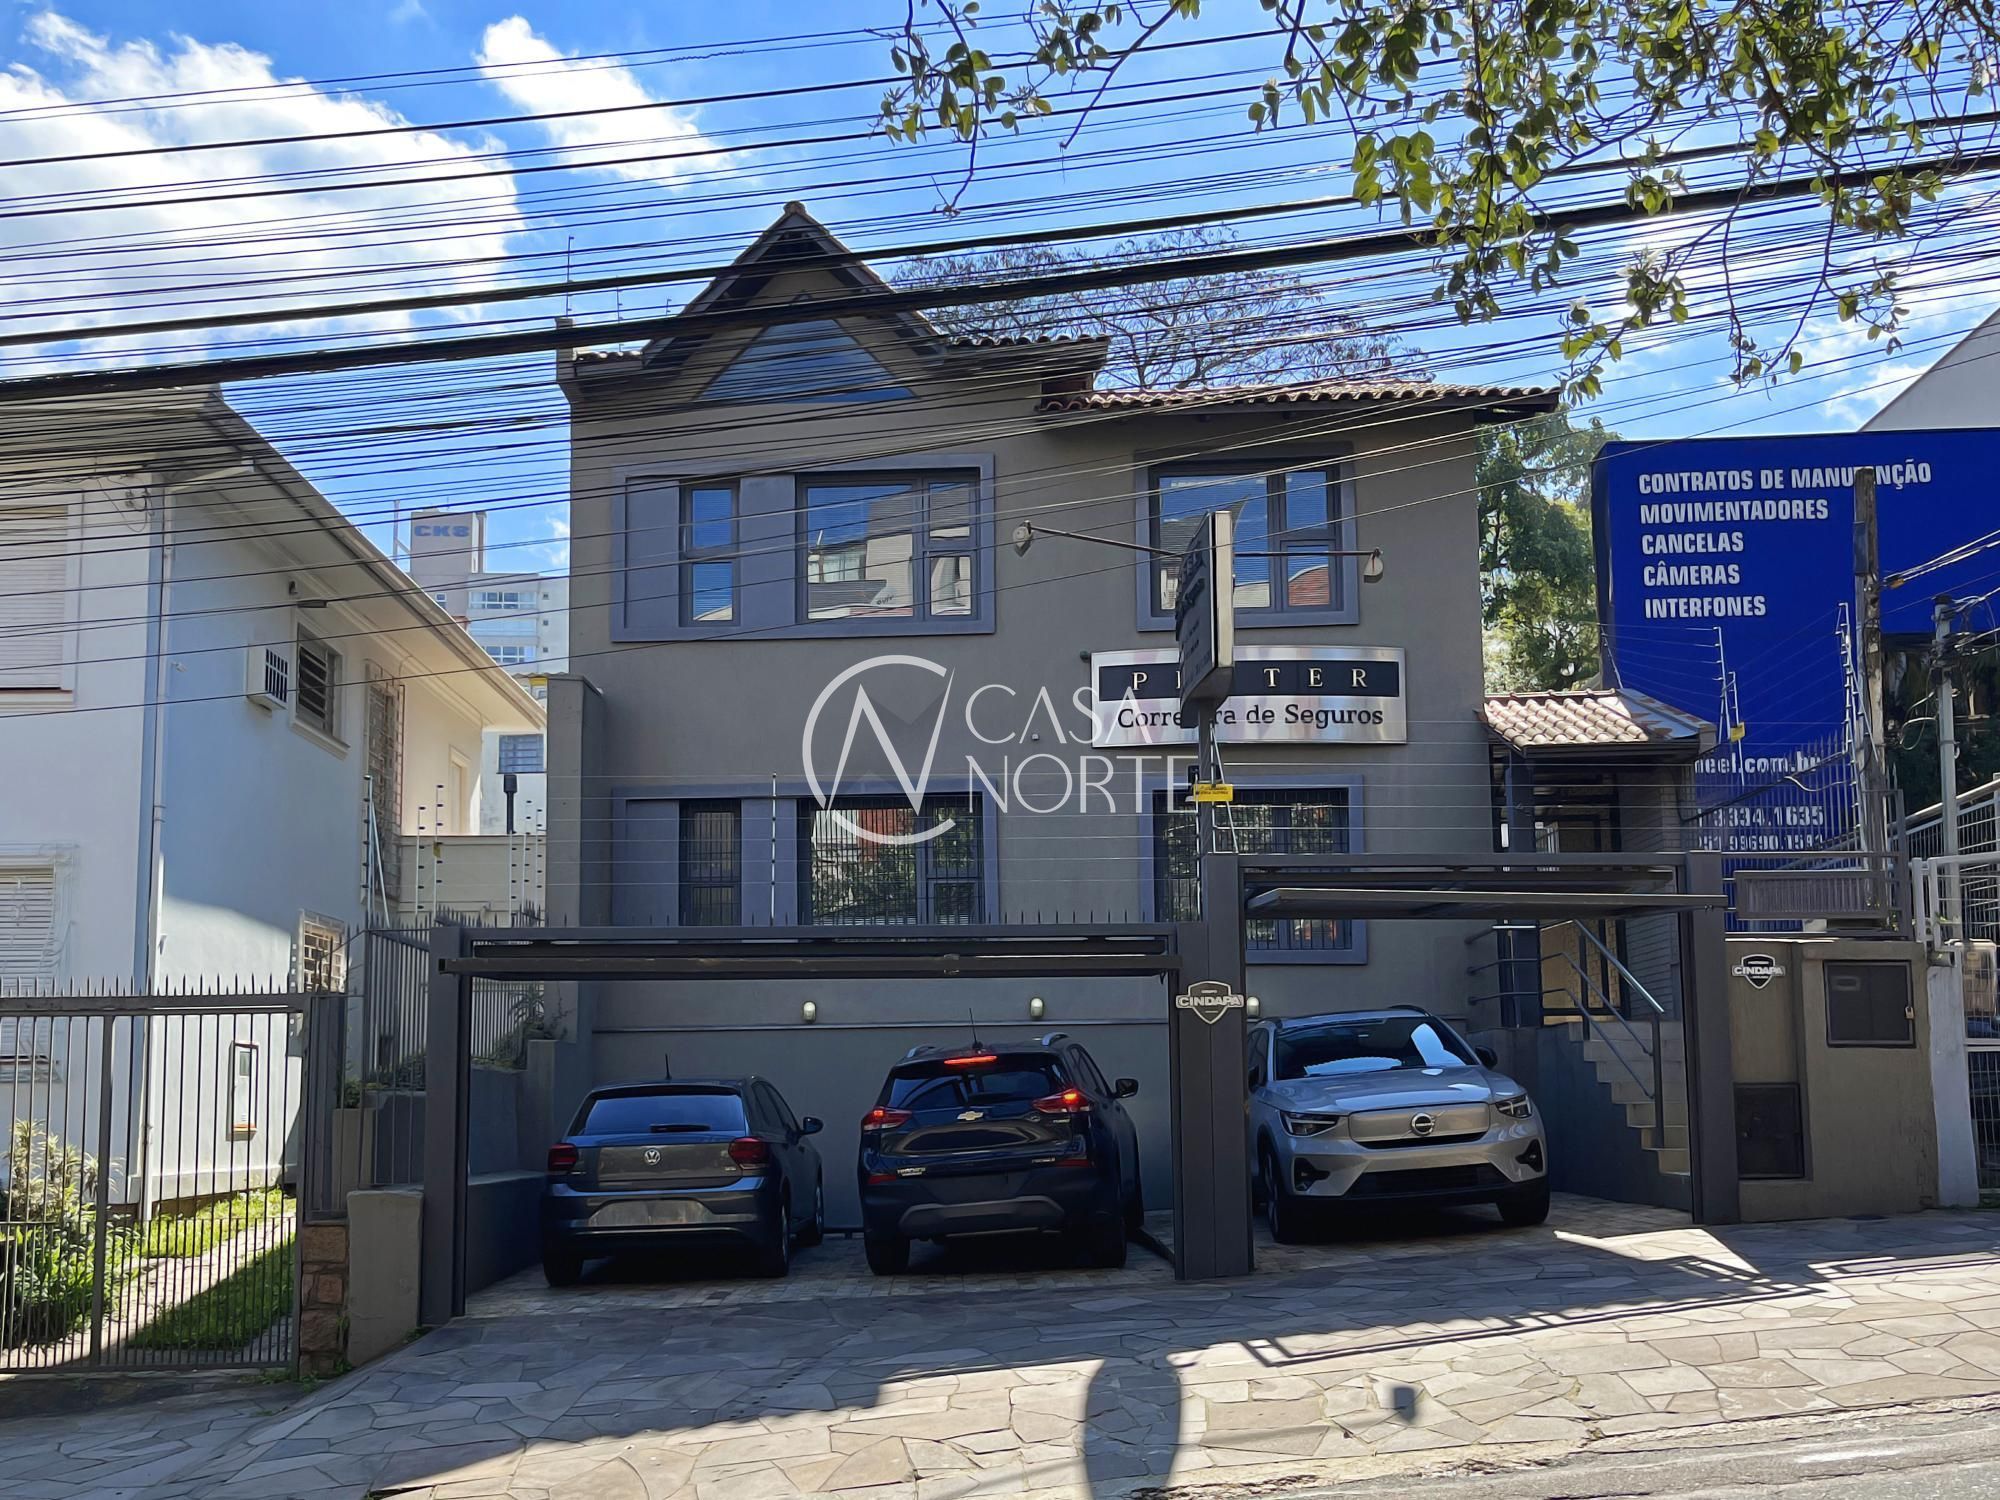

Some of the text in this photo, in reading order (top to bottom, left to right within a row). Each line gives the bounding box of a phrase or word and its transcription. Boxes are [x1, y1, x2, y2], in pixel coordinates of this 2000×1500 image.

[1638, 459, 1932, 494] CONTRATOS DE MANUNÇÃO
[1640, 499, 1829, 524] MOVIMENTADORES
[1641, 532, 1744, 555] CANCELAS
[1643, 560, 1740, 587] CÂMERAS
[1645, 596, 1766, 619] INTERFONES
[1117, 704, 1384, 729] Correra de Seguros
[1733, 966, 1783, 975] CINDAPA
[1179, 995, 1240, 1006] CINDAPA
